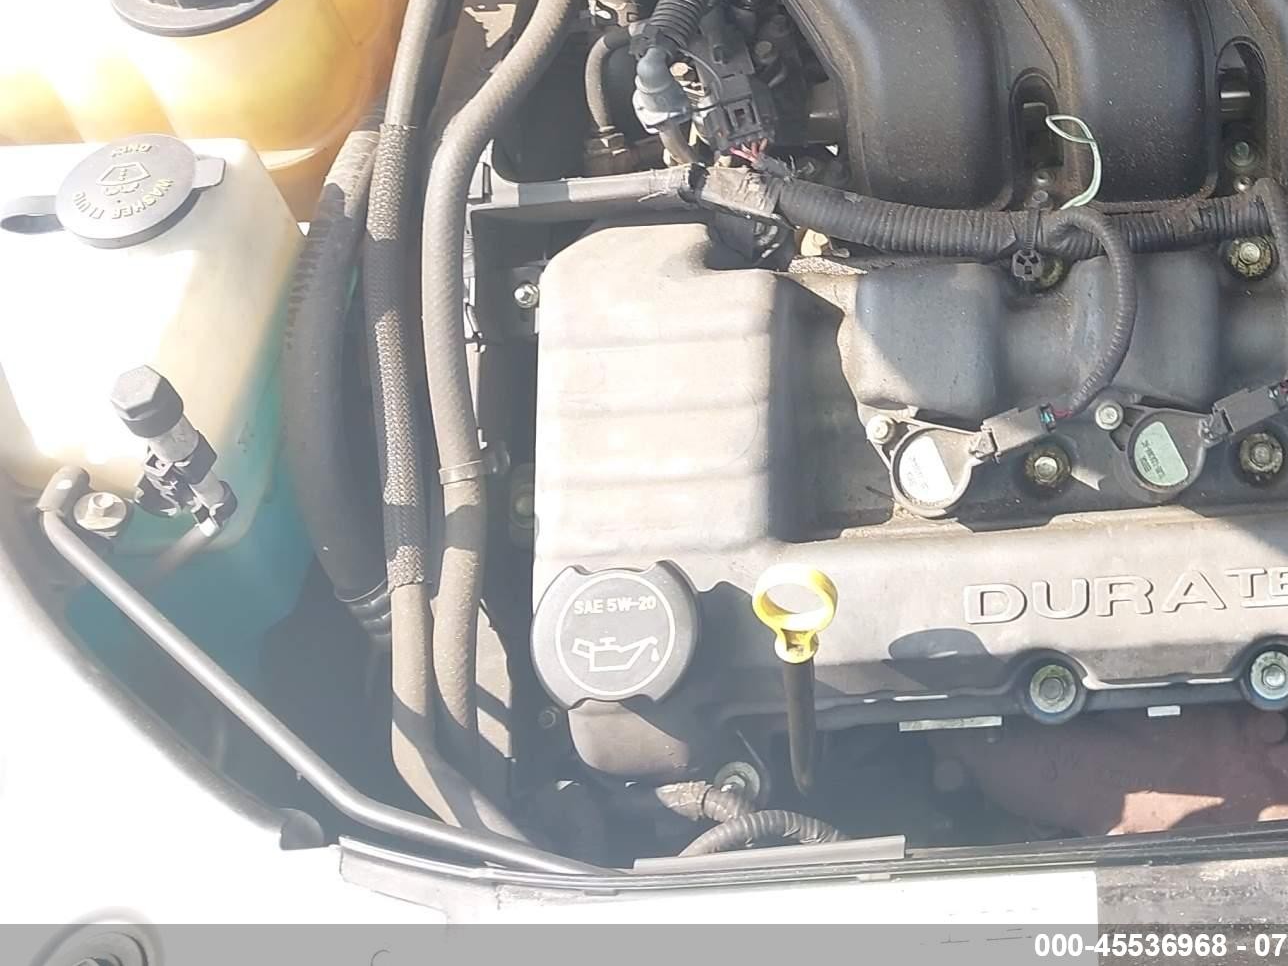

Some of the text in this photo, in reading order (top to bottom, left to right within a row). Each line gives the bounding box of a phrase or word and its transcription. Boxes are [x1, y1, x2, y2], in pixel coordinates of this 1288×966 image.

[112, 178, 174, 220] WASHER
[574, 596, 657, 614] SAE 5W-20
